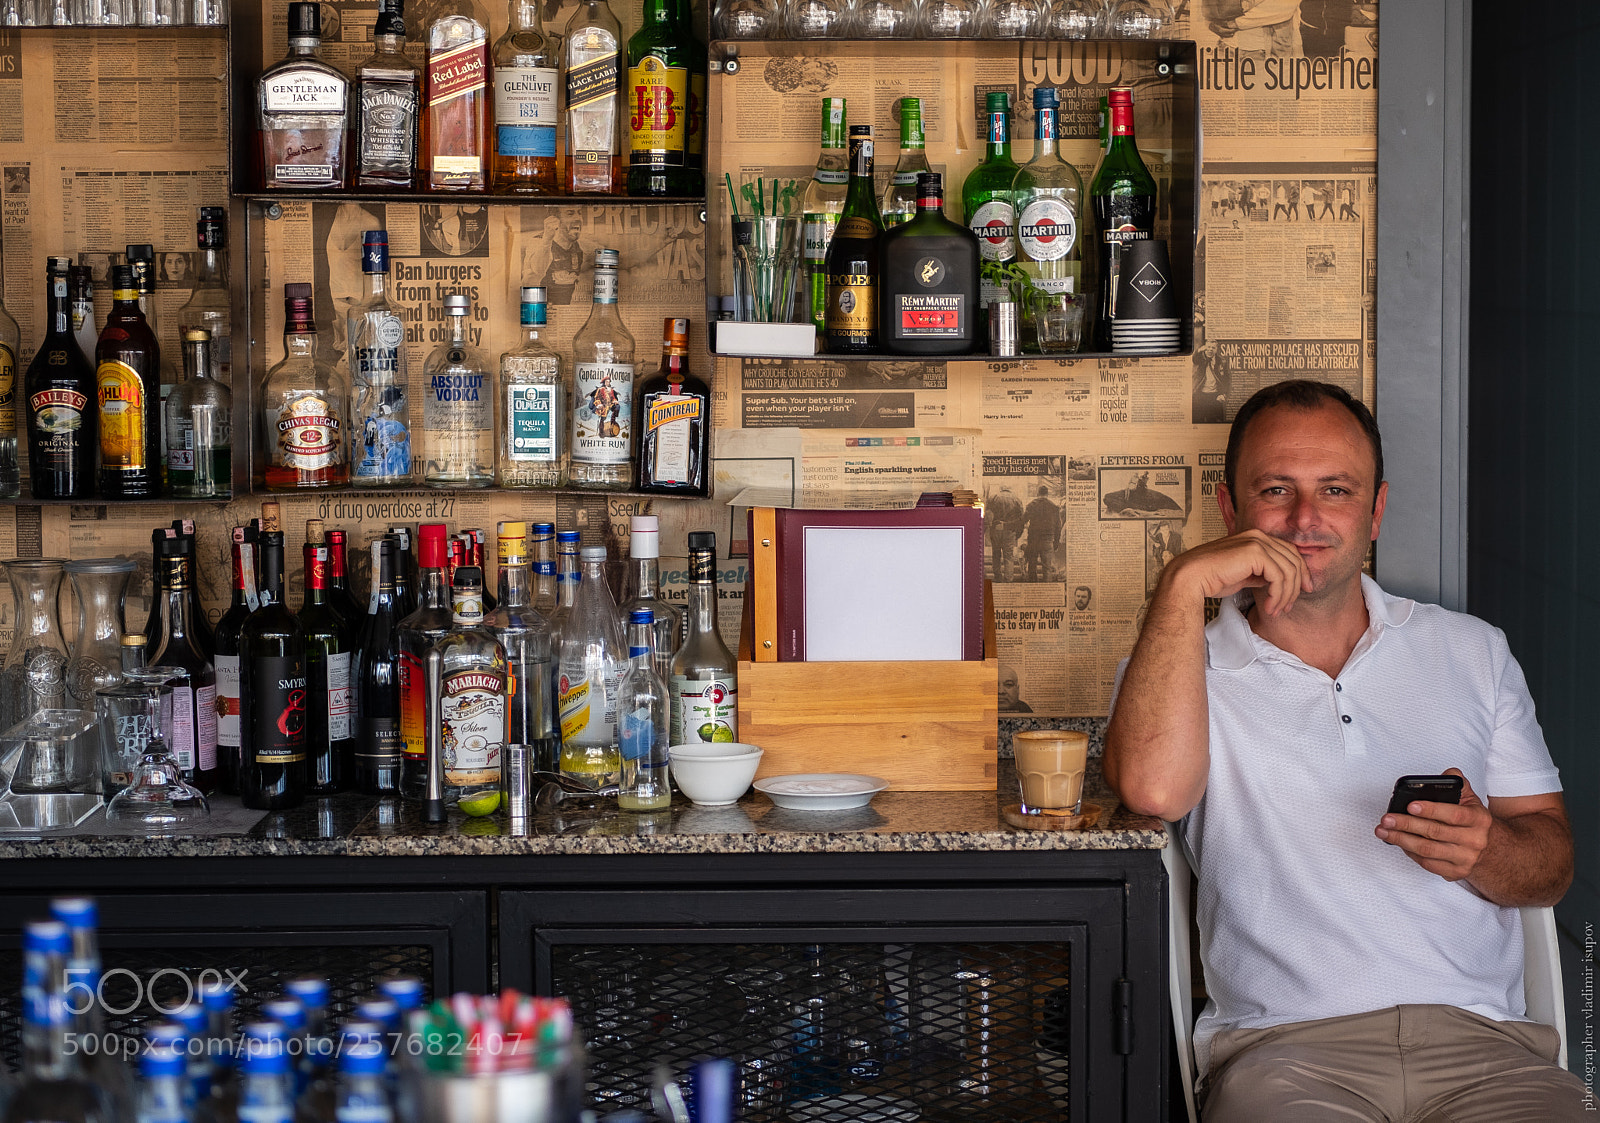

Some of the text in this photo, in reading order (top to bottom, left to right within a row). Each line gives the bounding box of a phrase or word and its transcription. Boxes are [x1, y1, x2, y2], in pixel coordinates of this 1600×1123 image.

[1022, 41, 1122, 84] GOOD
[1200, 46, 1256, 90] little
[432, 58, 485, 84] Red Label
[521, 74, 536, 82] THE
[568, 75, 592, 90] BLACK
[504, 81, 552, 92] GLENLIVET
[1078, 87, 1094, 98] Kane
[293, 94, 318, 102] JACK
[362, 96, 382, 110] JACK
[1068, 98, 1080, 110] the
[520, 110, 538, 118] 1824
[1060, 112, 1076, 122] next
[370, 126, 406, 134] Tennessee
[1059, 124, 1100, 137] Spurs to the
[4, 200, 26, 208] Players
[20, 208, 29, 216] rid
[4, 216, 26, 224] of Puel
[974, 228, 1014, 238] MARTIN
[1022, 225, 1070, 236] MARTINI
[1106, 231, 1148, 240] MARTINI
[396, 261, 482, 284] Ban burgers
[396, 282, 478, 302] from trains
[902, 296, 958, 306] RÉMY MARTIN
[474, 302, 488, 322] to
[408, 323, 424, 342] alt
[1220, 344, 1358, 356] SAM: SAVING PALACE HAS RESCUED
[361, 360, 400, 372] BLUE
[1229, 356, 1359, 369] ME FROM ENGLAND HEARTBREAK
[579, 366, 631, 382] Captain Morgan
[744, 368, 758, 378] WHY
[758, 368, 787, 378] CROUCHIE
[1100, 370, 1128, 384] Why we
[431, 376, 484, 388] ABSOLUT
[744, 378, 764, 388] WANTS
[765, 379, 772, 387] TO
[774, 378, 788, 388] PLAY
[788, 379, 798, 387] ON
[800, 378, 814, 387] UNTIL
[830, 378, 839, 388] 40
[436, 388, 480, 402] VODKA
[1100, 384, 1128, 396] must all
[33, 392, 84, 408] BAILEYS
[516, 400, 548, 410] OLMECA
[746, 397, 770, 406] Super
[808, 396, 828, 404] bet's
[829, 396, 844, 404] still
[1100, 397, 1128, 412] register
[652, 402, 697, 426] COINTREAU
[766, 404, 787, 412] when
[788, 406, 806, 414] your
[807, 404, 832, 414] player
[832, 404, 851, 412] isn't
[1100, 410, 1128, 422] to vote
[278, 417, 339, 431] CHIVAS REGAL
[518, 420, 546, 428] TEQUILA
[306, 432, 316, 440] 12
[580, 440, 626, 449] WHITE RUM
[1006, 456, 1030, 465] Harris
[1100, 456, 1184, 465] LETTERS FROM
[844, 466, 874, 474] English
[874, 466, 912, 474] sparkling
[983, 464, 1045, 474] ust by his dog...
[1202, 484, 1212, 496] KO
[319, 498, 456, 523] of drug overdose at 27
[1020, 609, 1064, 623] perv Daddy
[1008, 619, 1060, 632] to stay in UK
[447, 674, 500, 694] MARIACHI
[456, 700, 494, 718] TEQUILA
[461, 722, 488, 734] Silver
[570, 724, 584, 735] WATER
